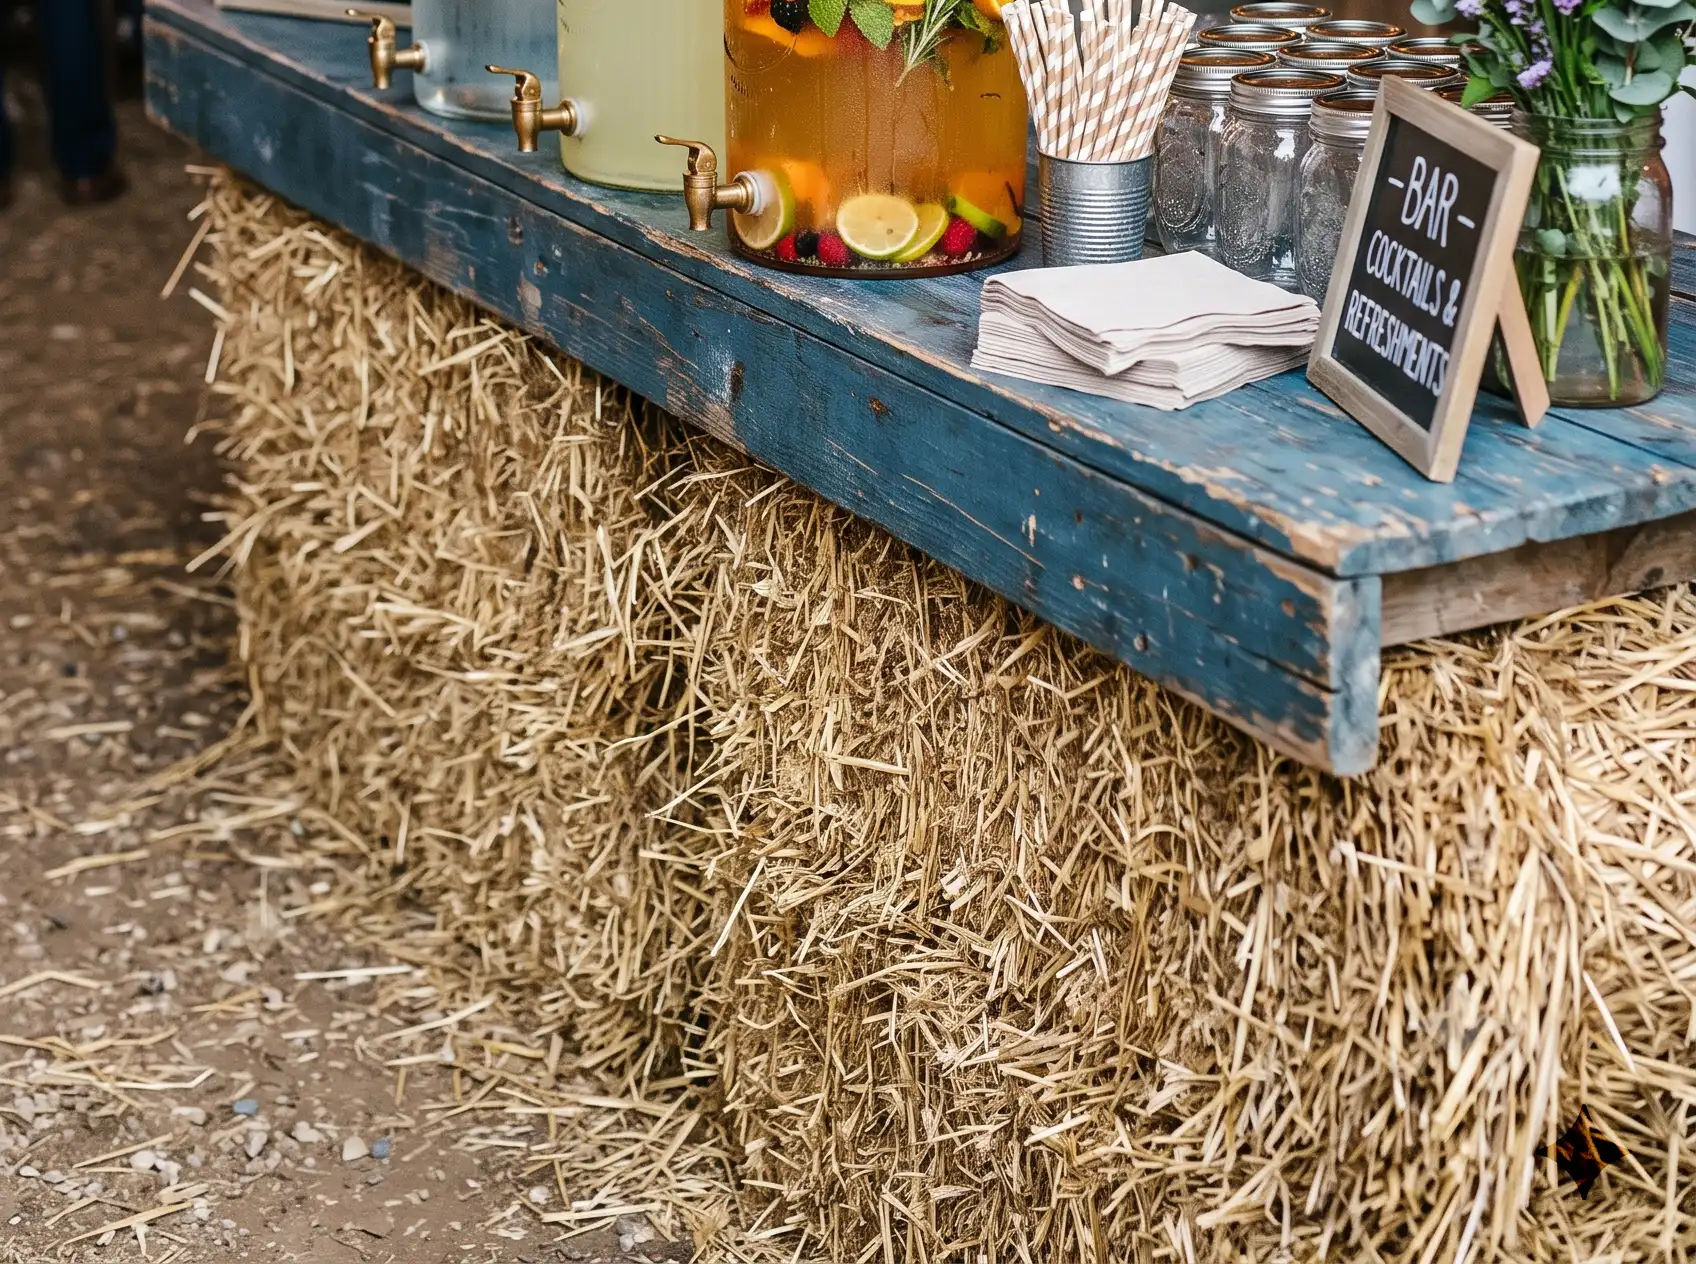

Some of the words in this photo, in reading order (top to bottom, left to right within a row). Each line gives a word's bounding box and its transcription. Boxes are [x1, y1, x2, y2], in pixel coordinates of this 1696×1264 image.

[1365, 229, 1447, 318] COCKTAILS
[1442, 278, 1462, 328] &
[1343, 289, 1450, 398] REFRESHMENTS
